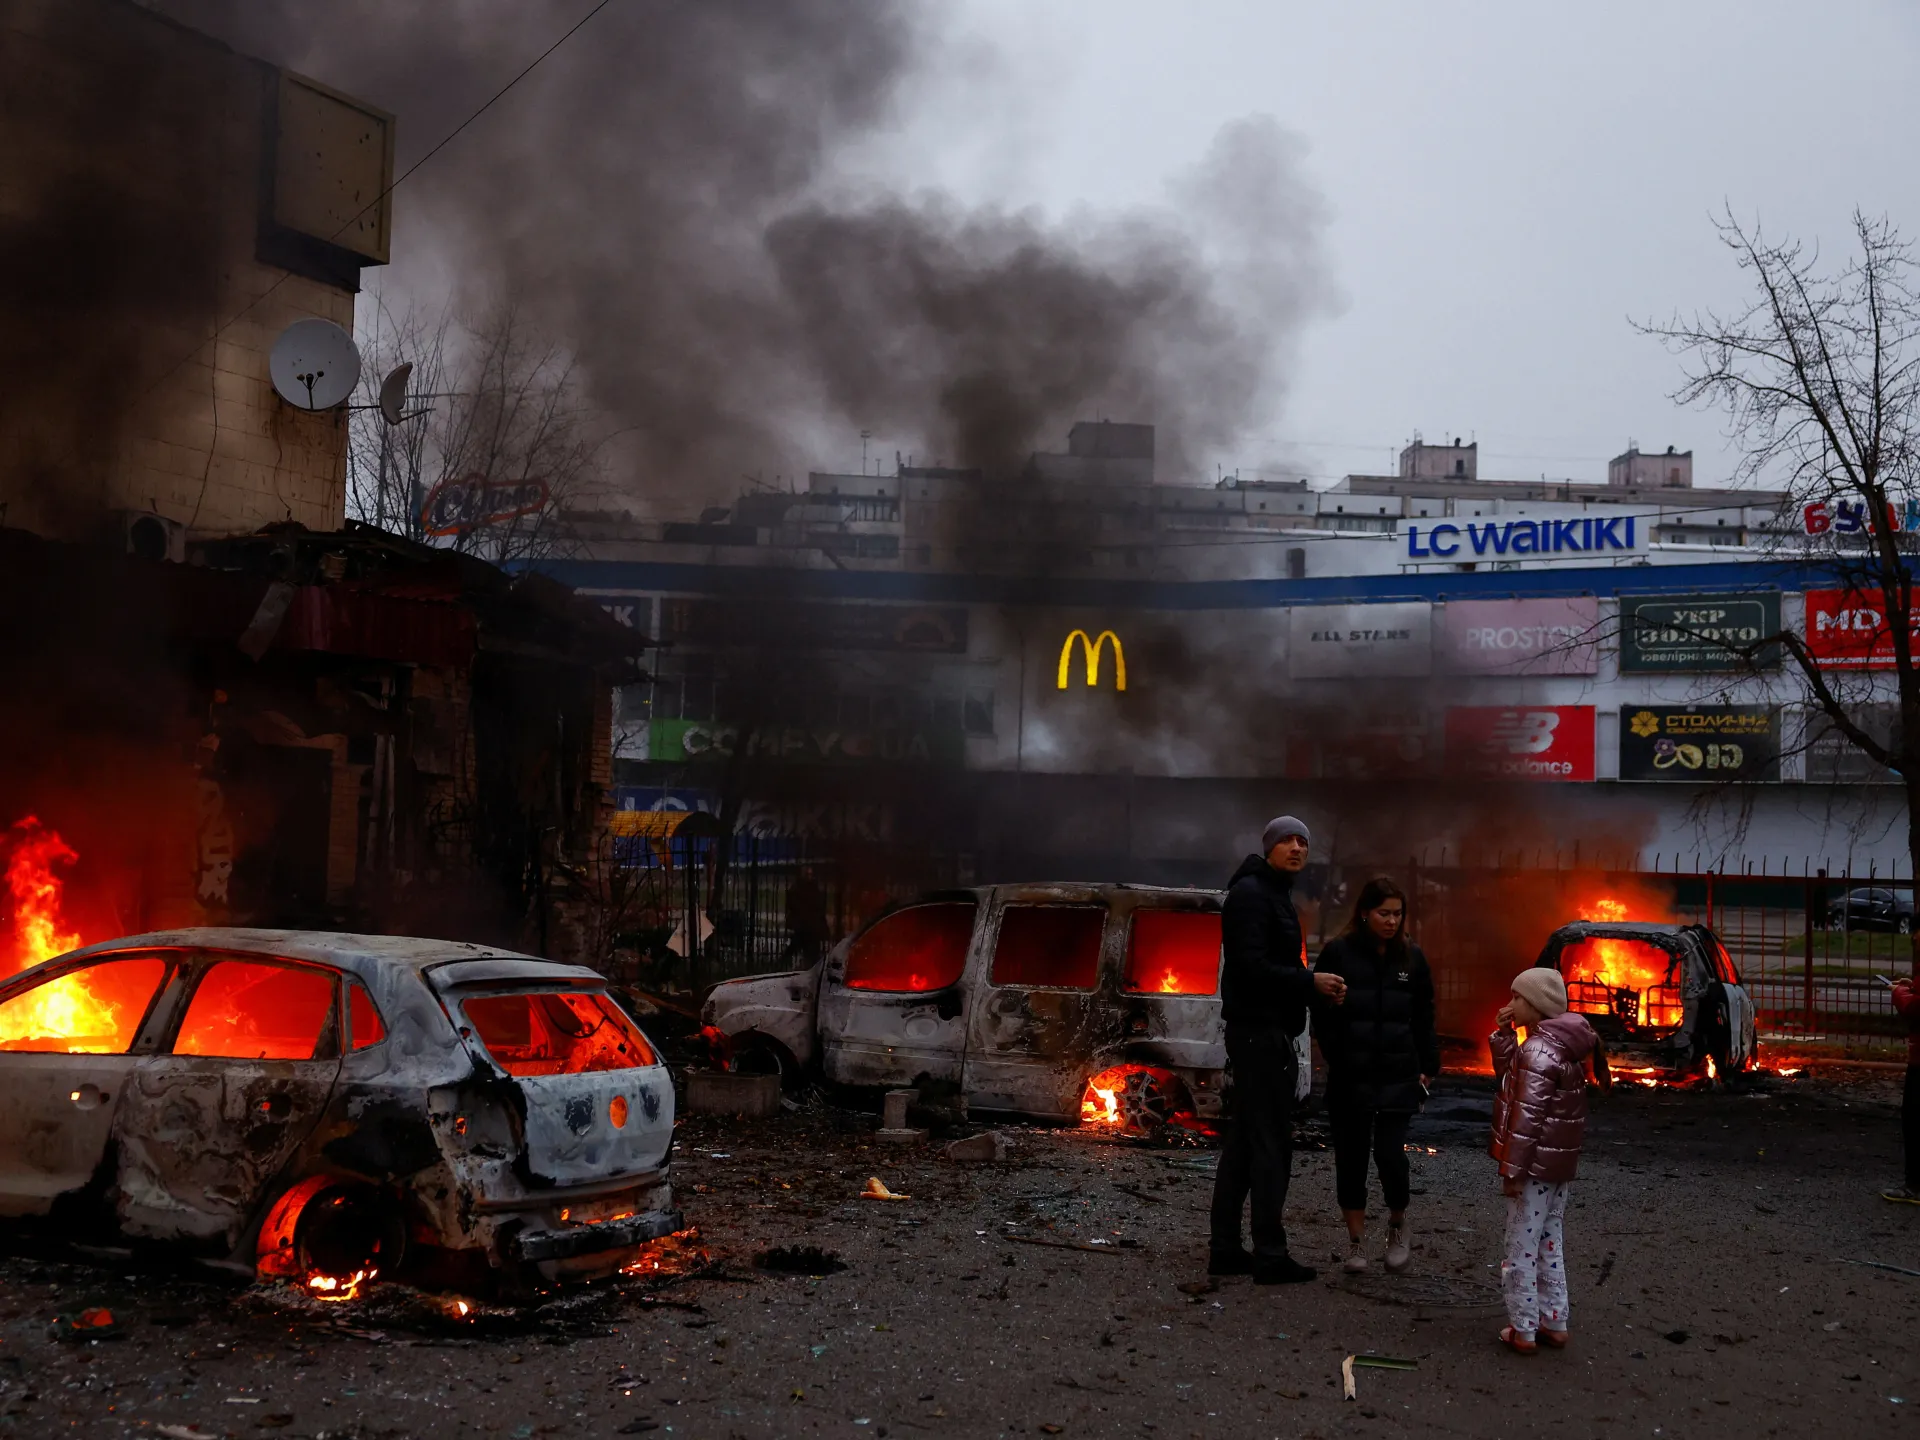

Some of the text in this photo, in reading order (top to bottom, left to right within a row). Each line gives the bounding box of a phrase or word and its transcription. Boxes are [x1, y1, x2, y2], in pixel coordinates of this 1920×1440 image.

[1408, 524, 1460, 557] LC
[1672, 609, 1726, 624] УКР
[1815, 608, 1881, 631] MD
[1311, 629, 1410, 642] ALL STARS
[1641, 627, 1759, 643] ЗОЛОТО
[1501, 758, 1574, 776] balance
